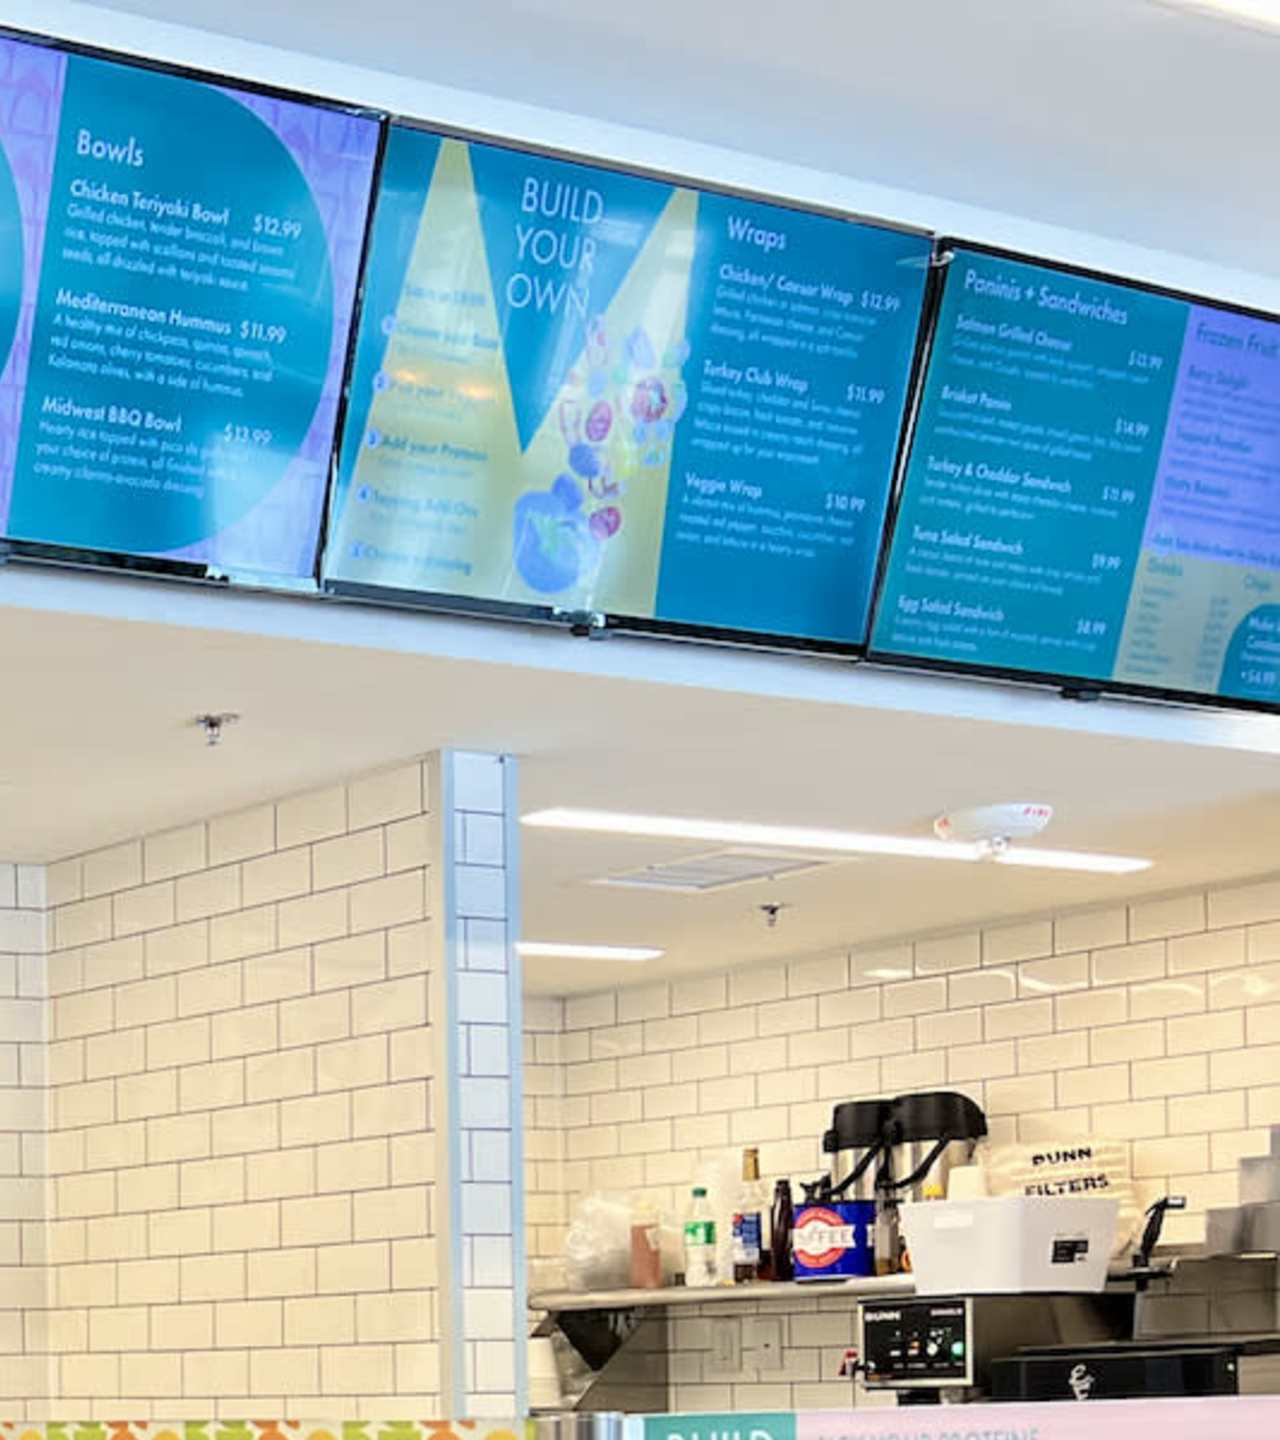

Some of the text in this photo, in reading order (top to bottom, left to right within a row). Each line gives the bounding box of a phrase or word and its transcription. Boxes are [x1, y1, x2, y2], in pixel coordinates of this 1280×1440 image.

[77, 128, 144, 167] Bowls
[70, 179, 230, 226] Chicken Teriyaki Bowl
[521, 176, 605, 225] BUILD
[253, 212, 302, 240] $12.99
[728, 216, 787, 254] Wraps
[514, 222, 599, 274] YOUR
[505, 272, 591, 322] OWN
[776, 274, 821, 298] Caesar
[820, 283, 854, 307] Wrap
[861, 290, 901, 313] $12.99
[965, 268, 1021, 301] Paninis
[1038, 285, 1129, 326] Sandwiches
[56, 288, 232, 335] Mediterranean Hummus
[241, 319, 288, 345] $11.99
[955, 313, 1073, 351] Salmon Grilled Cheese
[703, 359, 809, 394] Turkey Club Wrap
[941, 384, 979, 405] Brisket
[42, 395, 182, 433] Midwest BBQ Bowl
[223, 421, 273, 445] $13.99
[685, 471, 763, 500] Veggie Wrap
[927, 455, 963, 478] Turkey
[976, 462, 1022, 486] Cheddar
[1022, 471, 1072, 494] Sandwich
[825, 492, 867, 513] $10.99
[913, 524, 1024, 556] Tuna Salad Sandwich
[898, 594, 1005, 622] Egg Salad Sandwich
[1025, 1173, 1109, 1196] FILTERS
